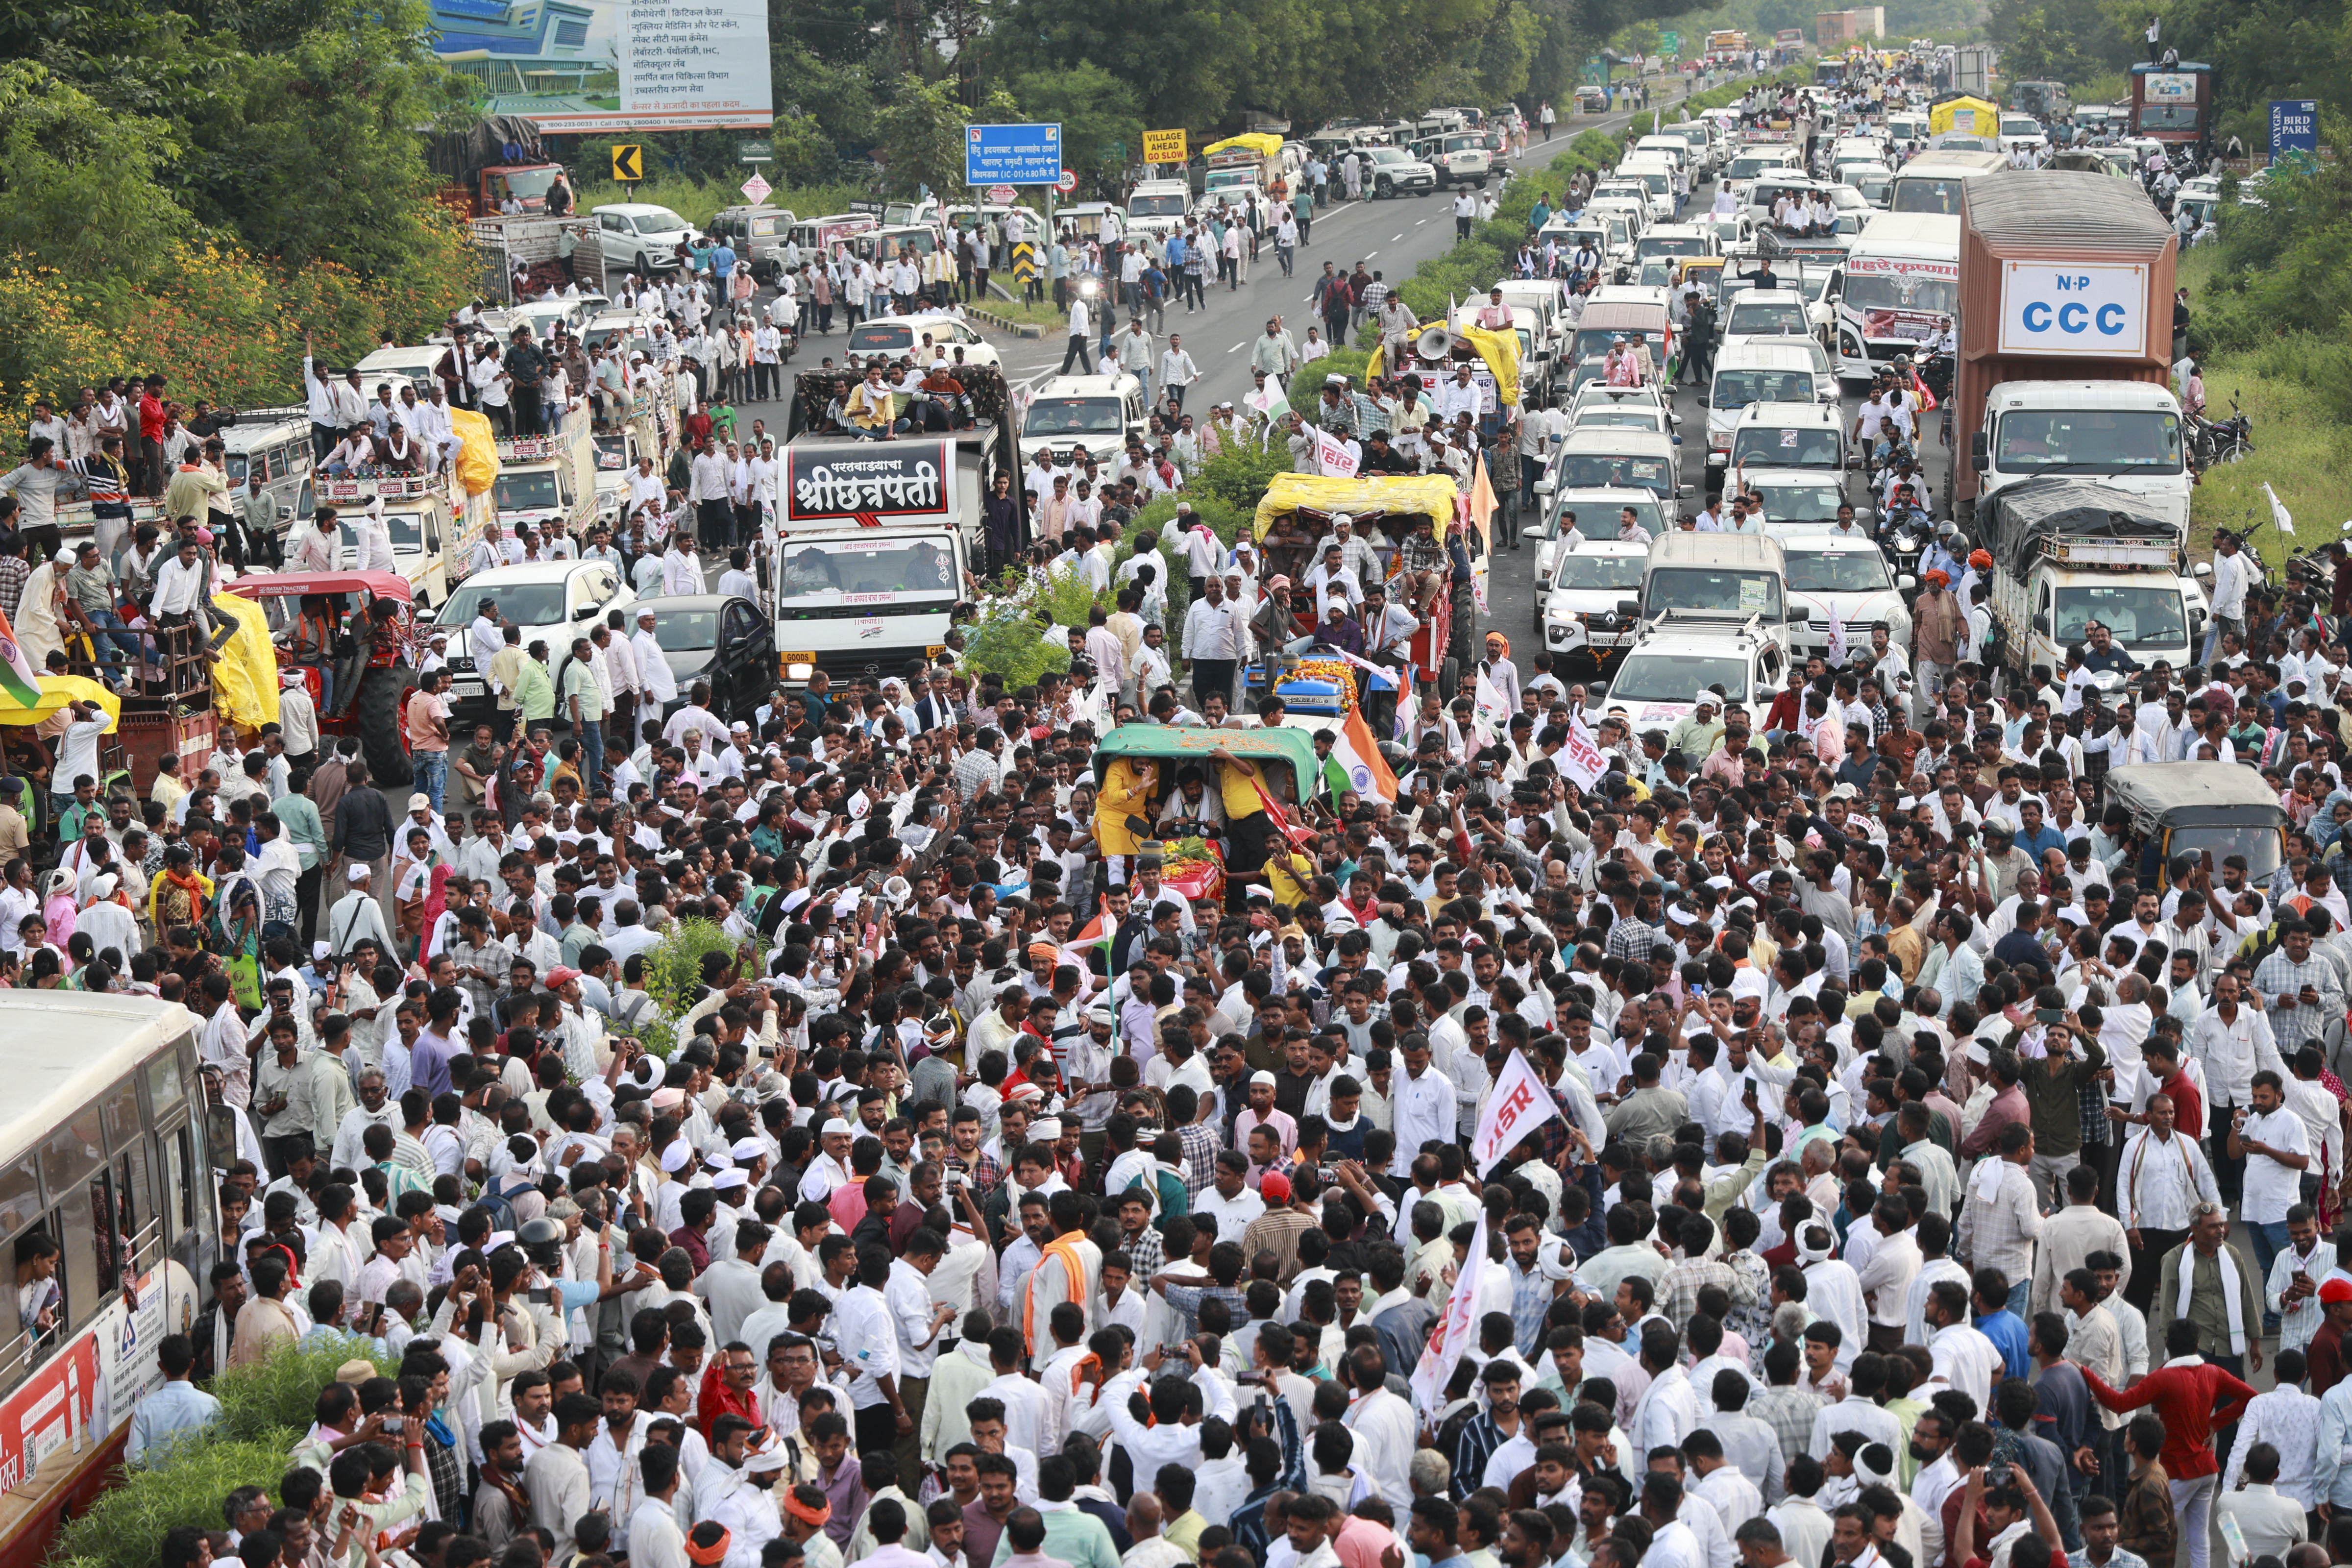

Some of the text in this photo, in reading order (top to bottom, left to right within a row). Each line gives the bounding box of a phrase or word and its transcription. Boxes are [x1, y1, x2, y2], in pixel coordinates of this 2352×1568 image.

[631, 9, 665, 18] कीमोथेरपी
[672, 8, 703, 17] क्रिटिकल
[665, 21, 691, 30] मेडिसिन
[694, 20, 707, 28] और
[653, 34, 668, 43] सीटी
[634, 72, 658, 81] समर्पित
[675, 72, 706, 80] चिकित्सा
[708, 71, 729, 79] विभाग
[635, 85, 668, 94] उच्चस्तरीय
[689, 83, 704, 92] सेवा
[654, 101, 660, 110] से
[662, 100, 687, 109] आजादी
[2283, 116, 2310, 125] BIRD
[2282, 125, 2310, 134] PARK
[1147, 132, 1182, 142] VILLAGE
[1042, 143, 1056, 152] ठाकरे
[1151, 142, 1179, 151] AHEAD
[1162, 150, 1183, 159] SLOW
[981, 158, 1003, 167] महाराष्ट्र
[1025, 155, 1045, 165] महामार्ग
[871, 203, 883, 212] कडे
[1478, 379, 1493, 388] पक्ष
[1853, 815, 1874, 832] प्रहार
